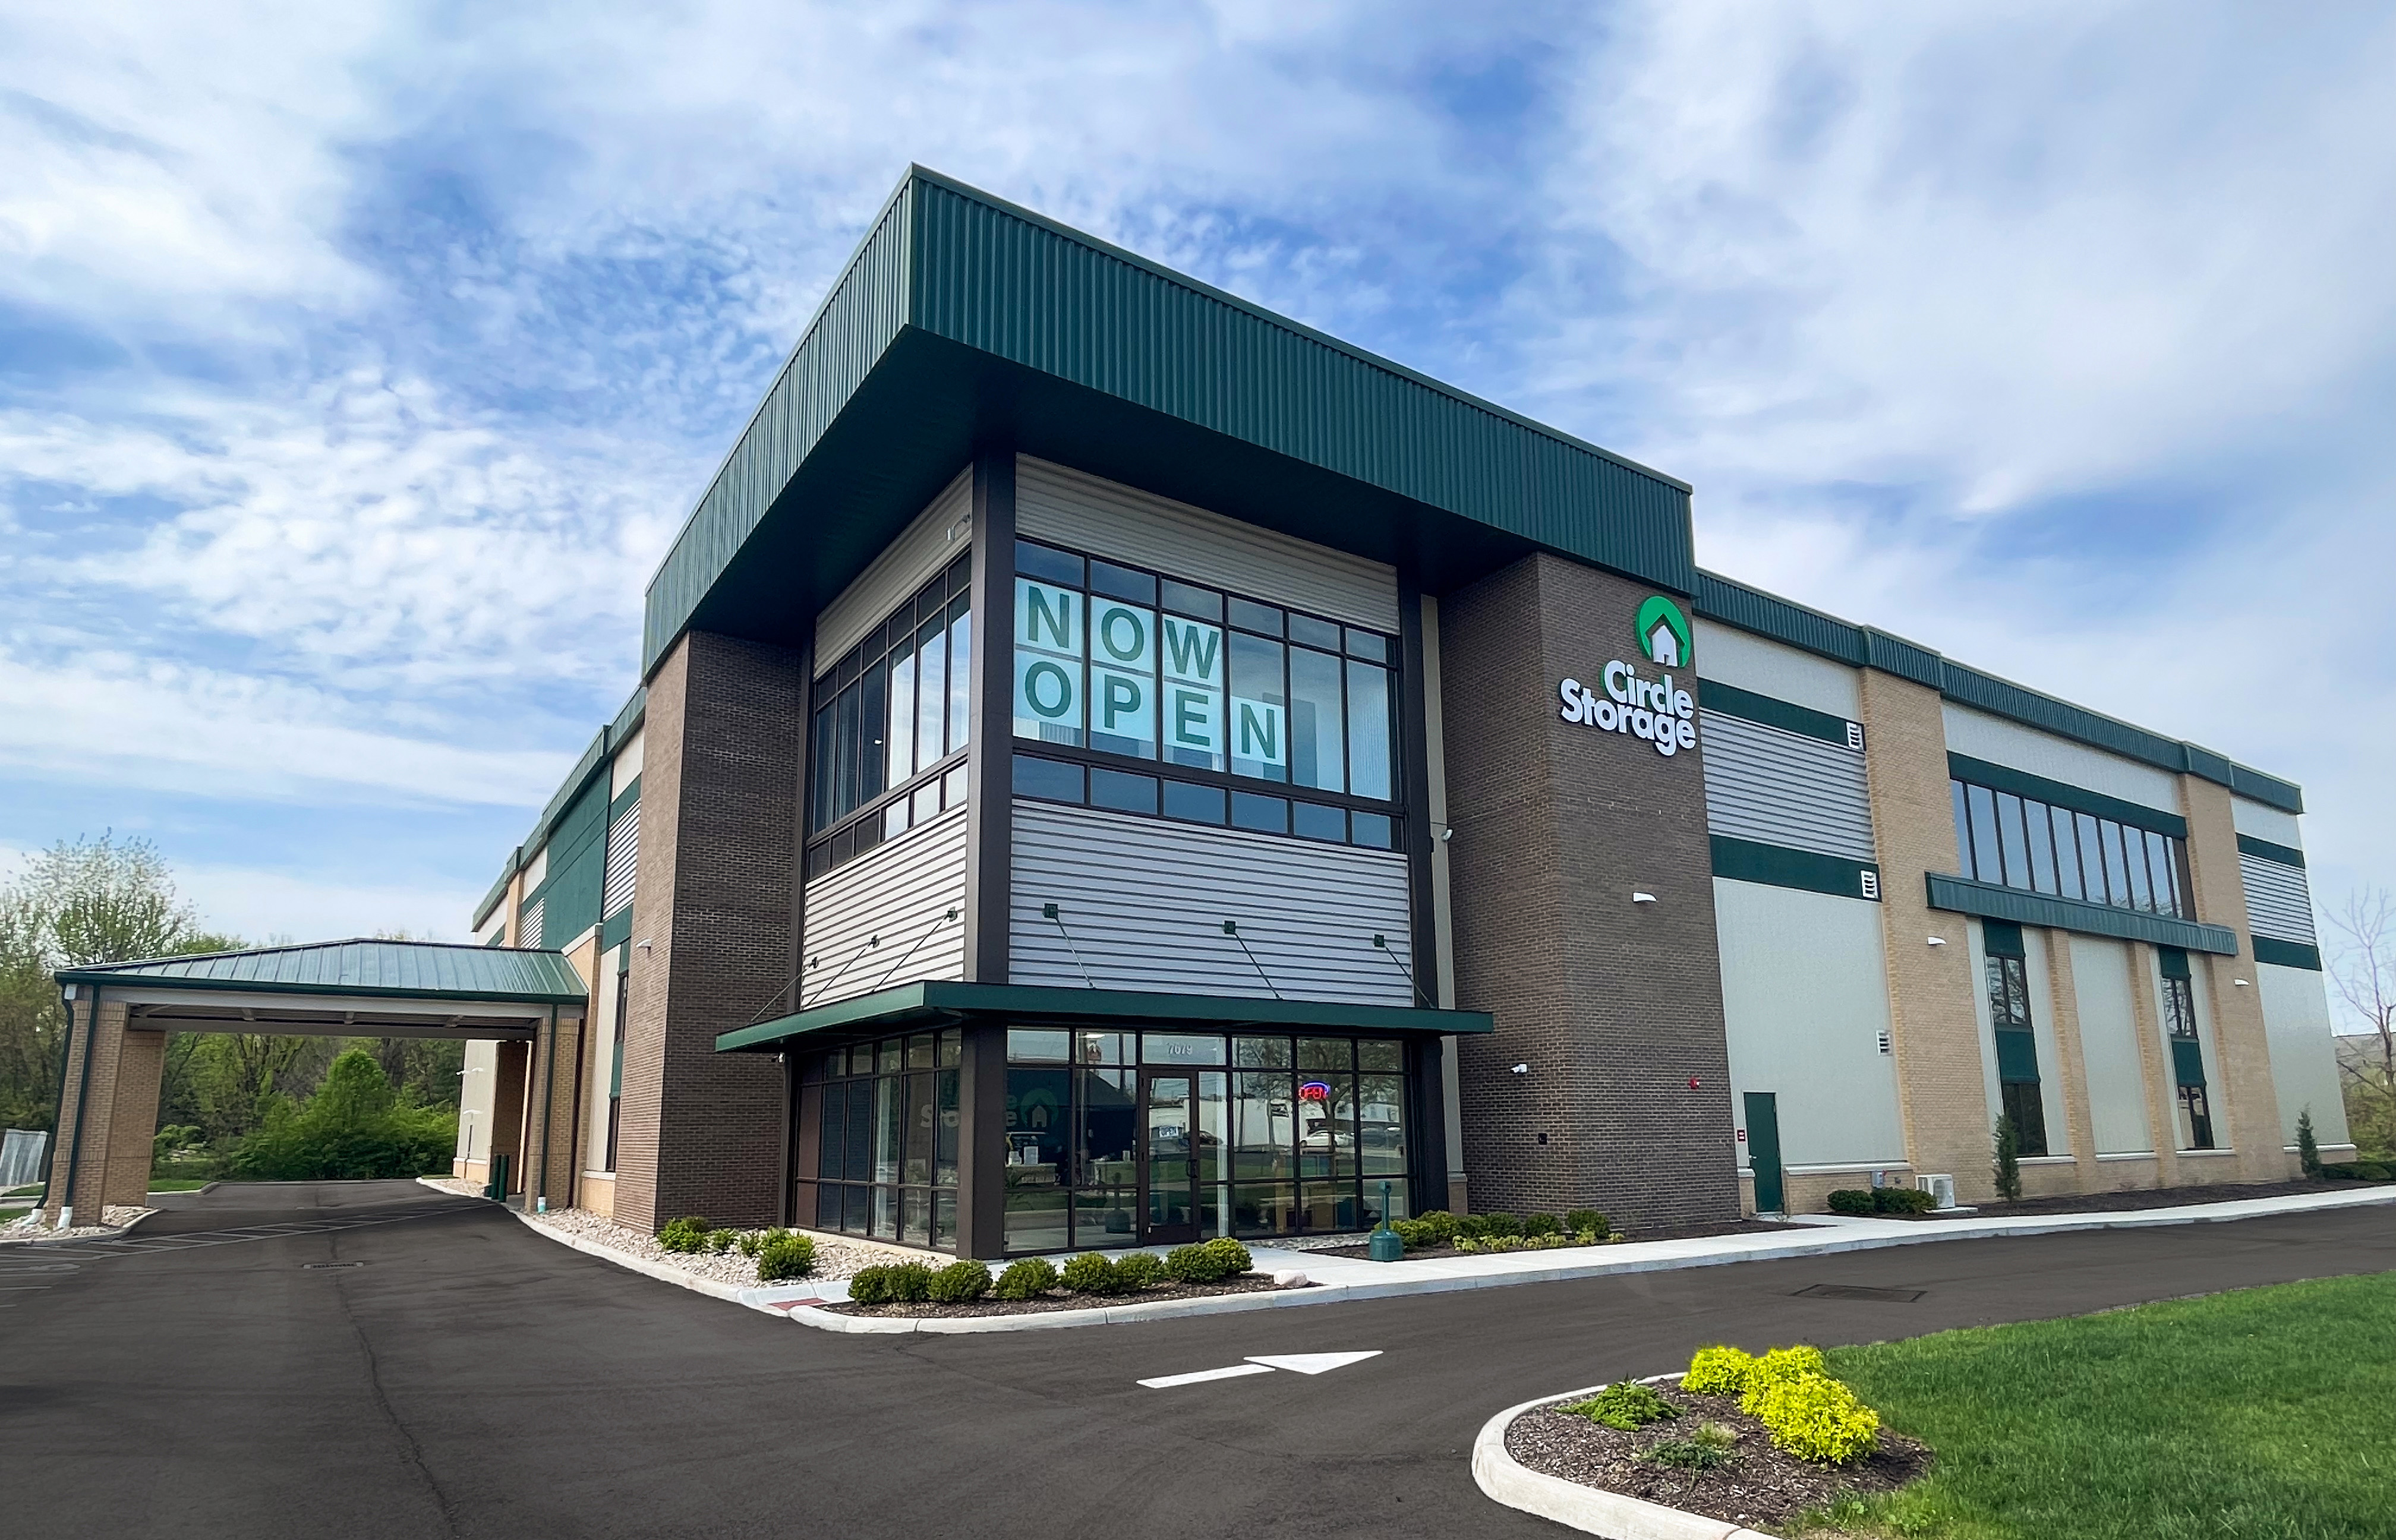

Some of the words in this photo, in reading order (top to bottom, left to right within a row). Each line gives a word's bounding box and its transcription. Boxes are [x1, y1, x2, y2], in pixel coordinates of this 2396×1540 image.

[1028, 586, 1219, 679] NOW
[1024, 661, 1276, 759] OPEN
[1560, 678, 1696, 756] Storage
[1603, 659, 1694, 719] Circle
[1298, 1086, 1327, 1100] OPEN
